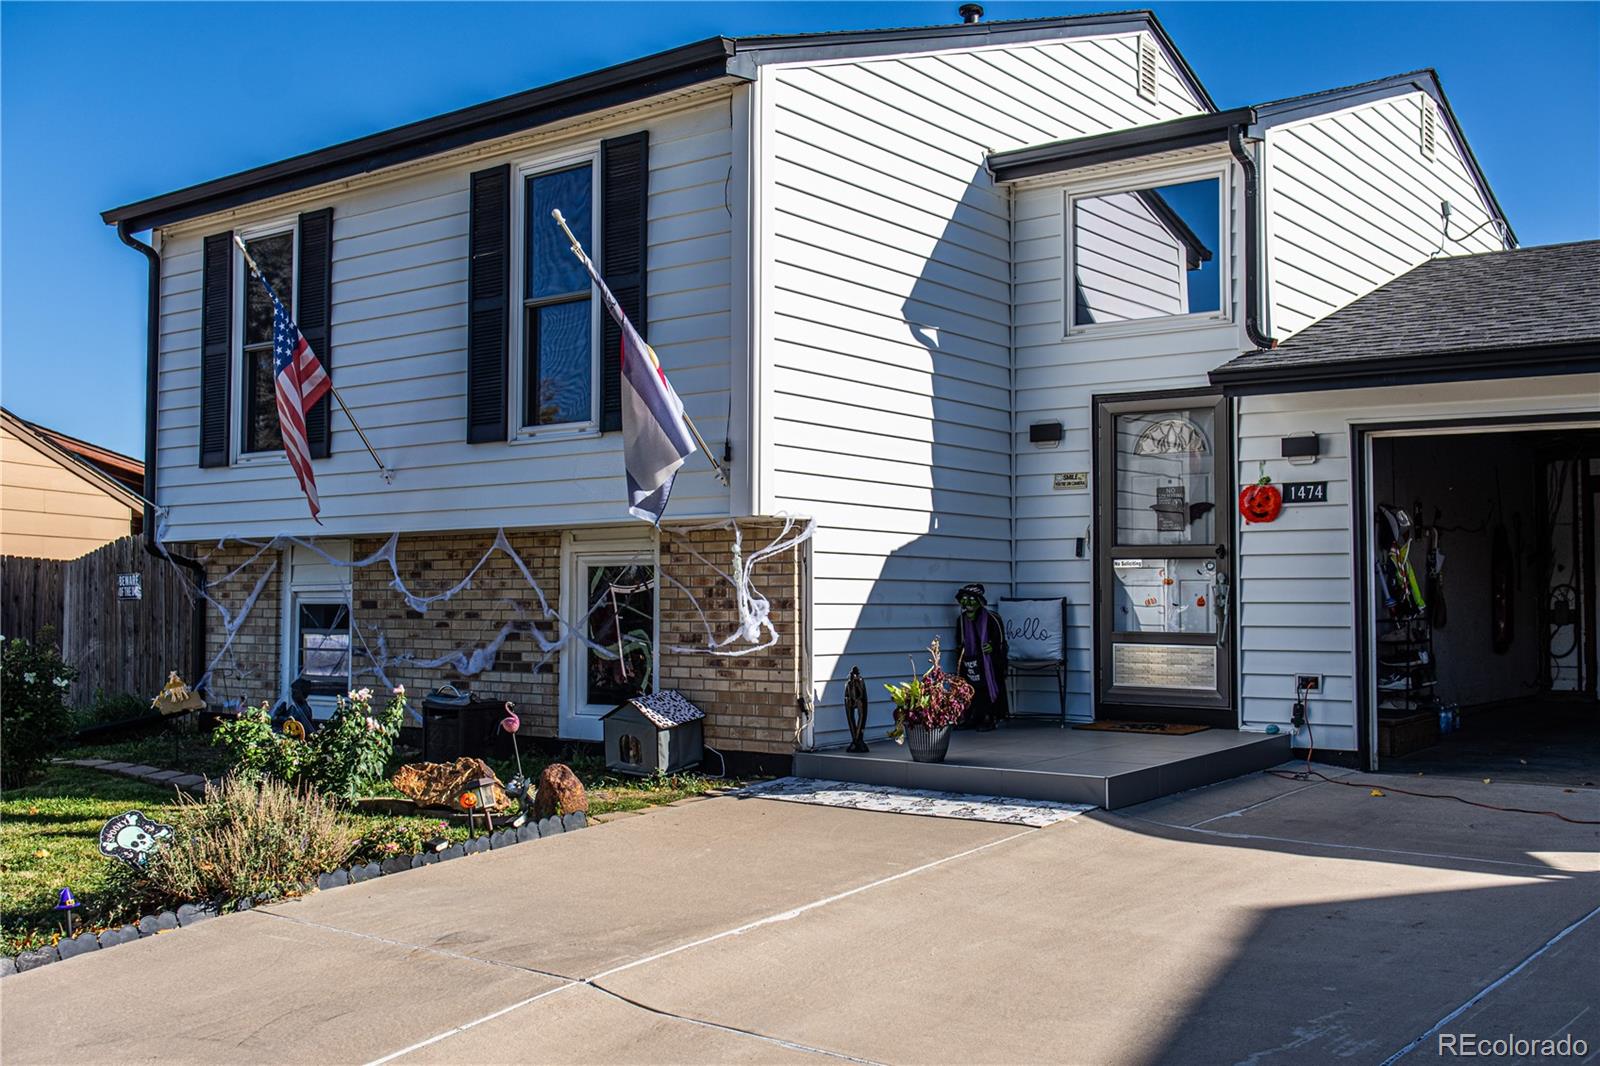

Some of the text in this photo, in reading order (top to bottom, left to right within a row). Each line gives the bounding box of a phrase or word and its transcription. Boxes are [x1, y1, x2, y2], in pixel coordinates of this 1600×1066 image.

[1291, 485, 1323, 499] 1474
[1121, 560, 1142, 568] Soliciting
[118, 574, 141, 586] BEWARE
[1006, 617, 1052, 641] hello
[106, 818, 129, 842] SPOOKY
